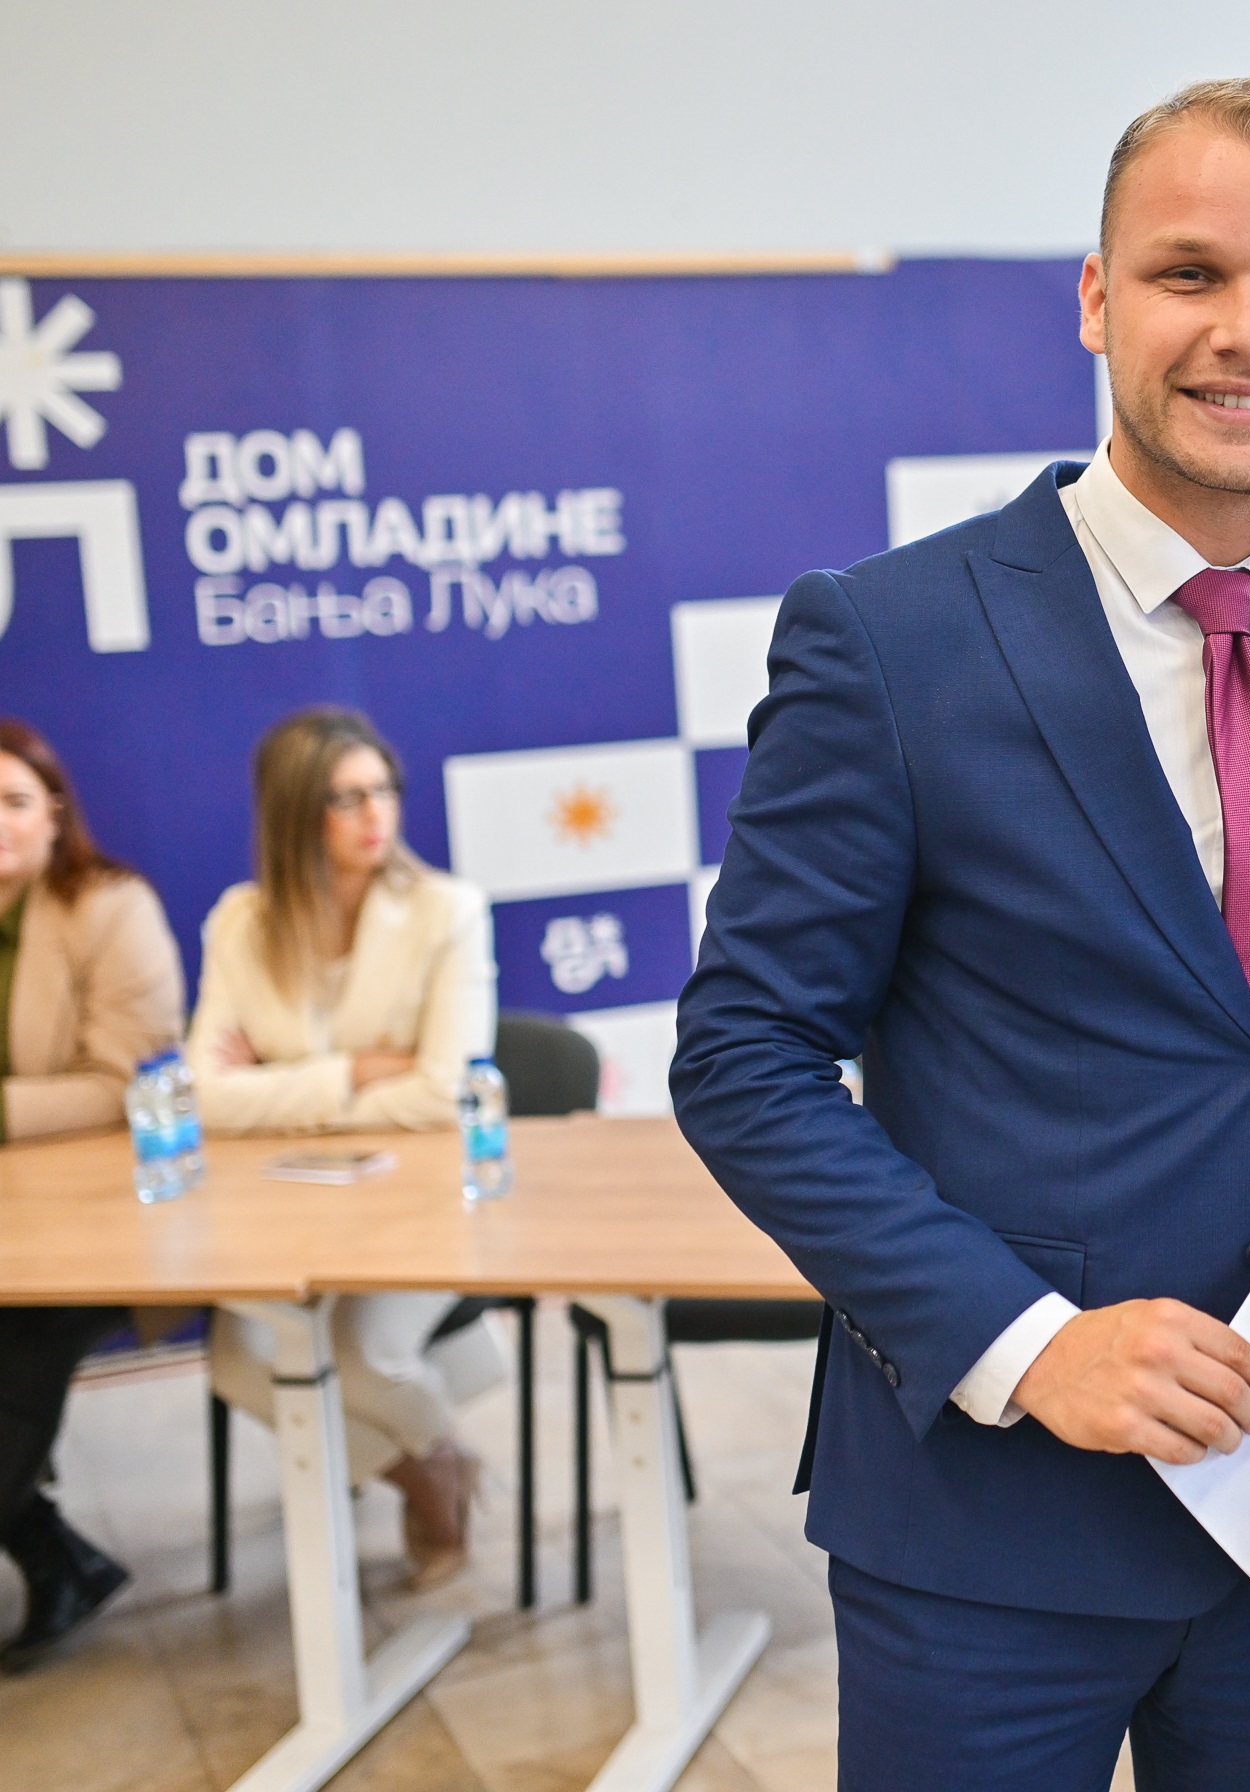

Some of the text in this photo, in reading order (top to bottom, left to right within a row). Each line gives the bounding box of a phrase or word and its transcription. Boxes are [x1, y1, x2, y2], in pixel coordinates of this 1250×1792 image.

[179, 427, 365, 509] ДОМ
[185, 487, 626, 574] ОМЛАДИНЕ
[195, 566, 598, 646] Бања Лука
